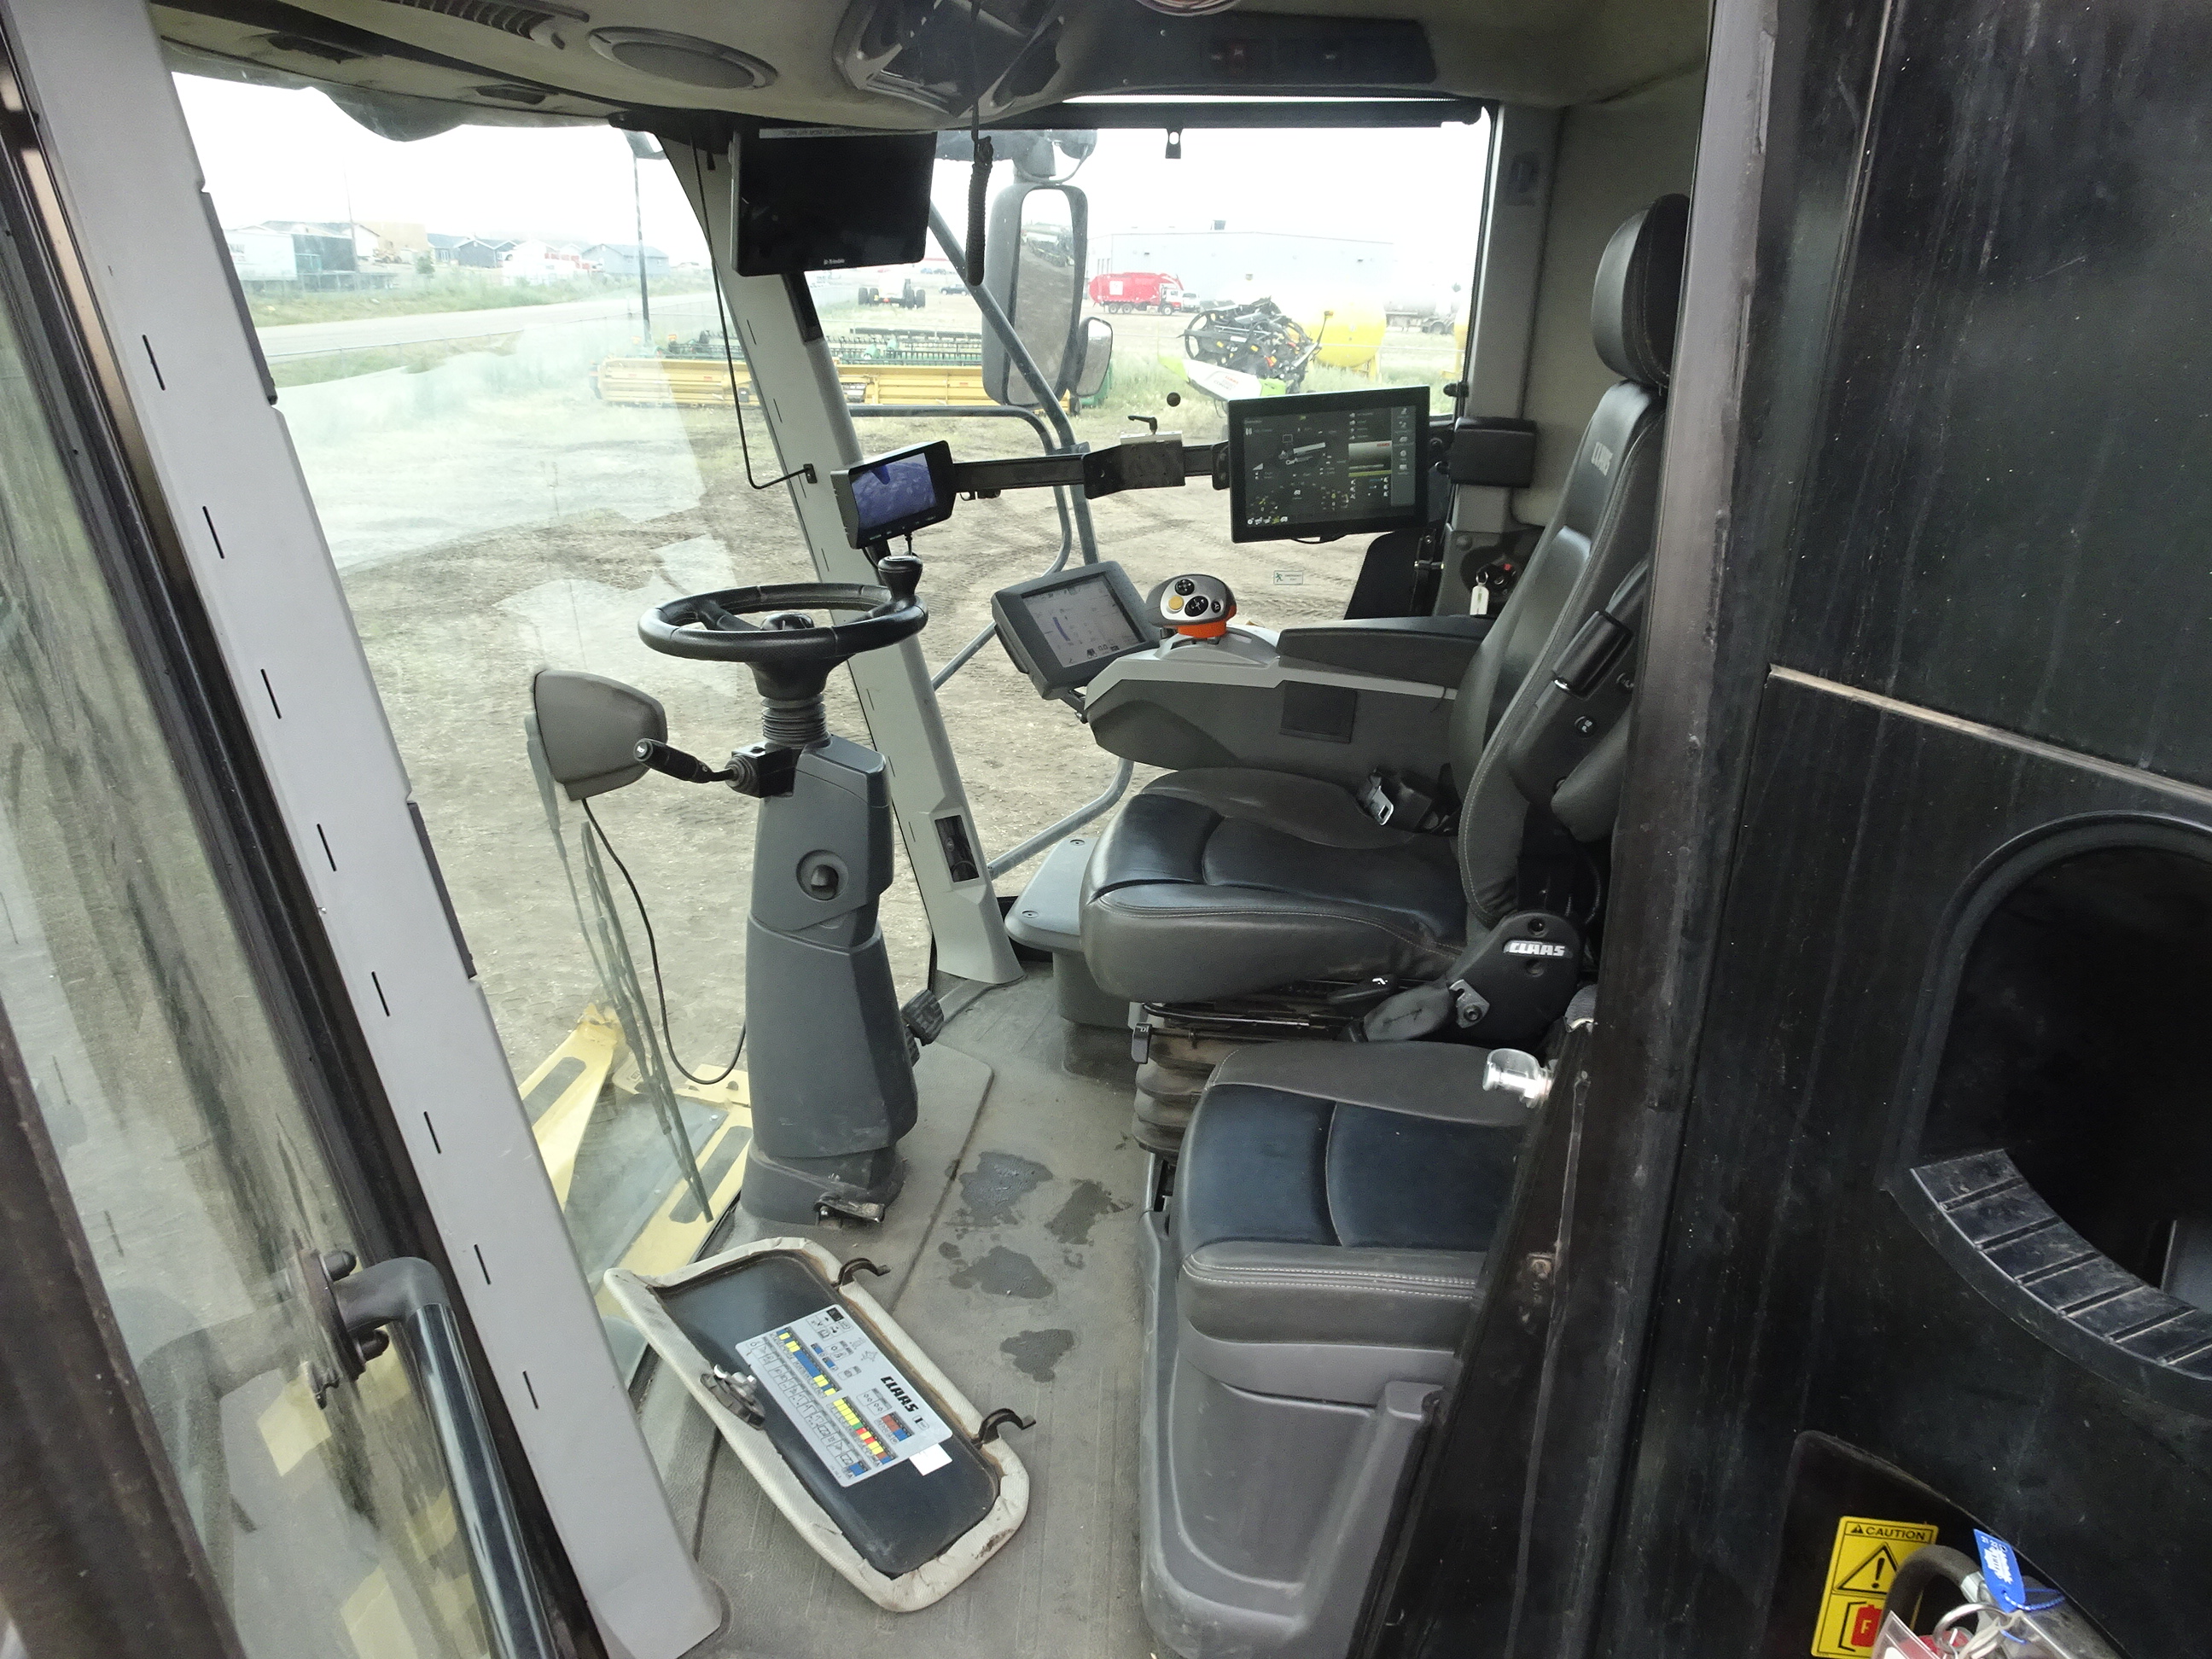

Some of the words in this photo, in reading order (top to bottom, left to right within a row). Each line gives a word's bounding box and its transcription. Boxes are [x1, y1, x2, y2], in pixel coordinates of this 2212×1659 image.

[1509, 942, 1566, 957] CLAAS
[880, 1376, 919, 1412] CLAAS
[1866, 1526, 1925, 1540] CAUTION
[1860, 1619, 1872, 1634] F
